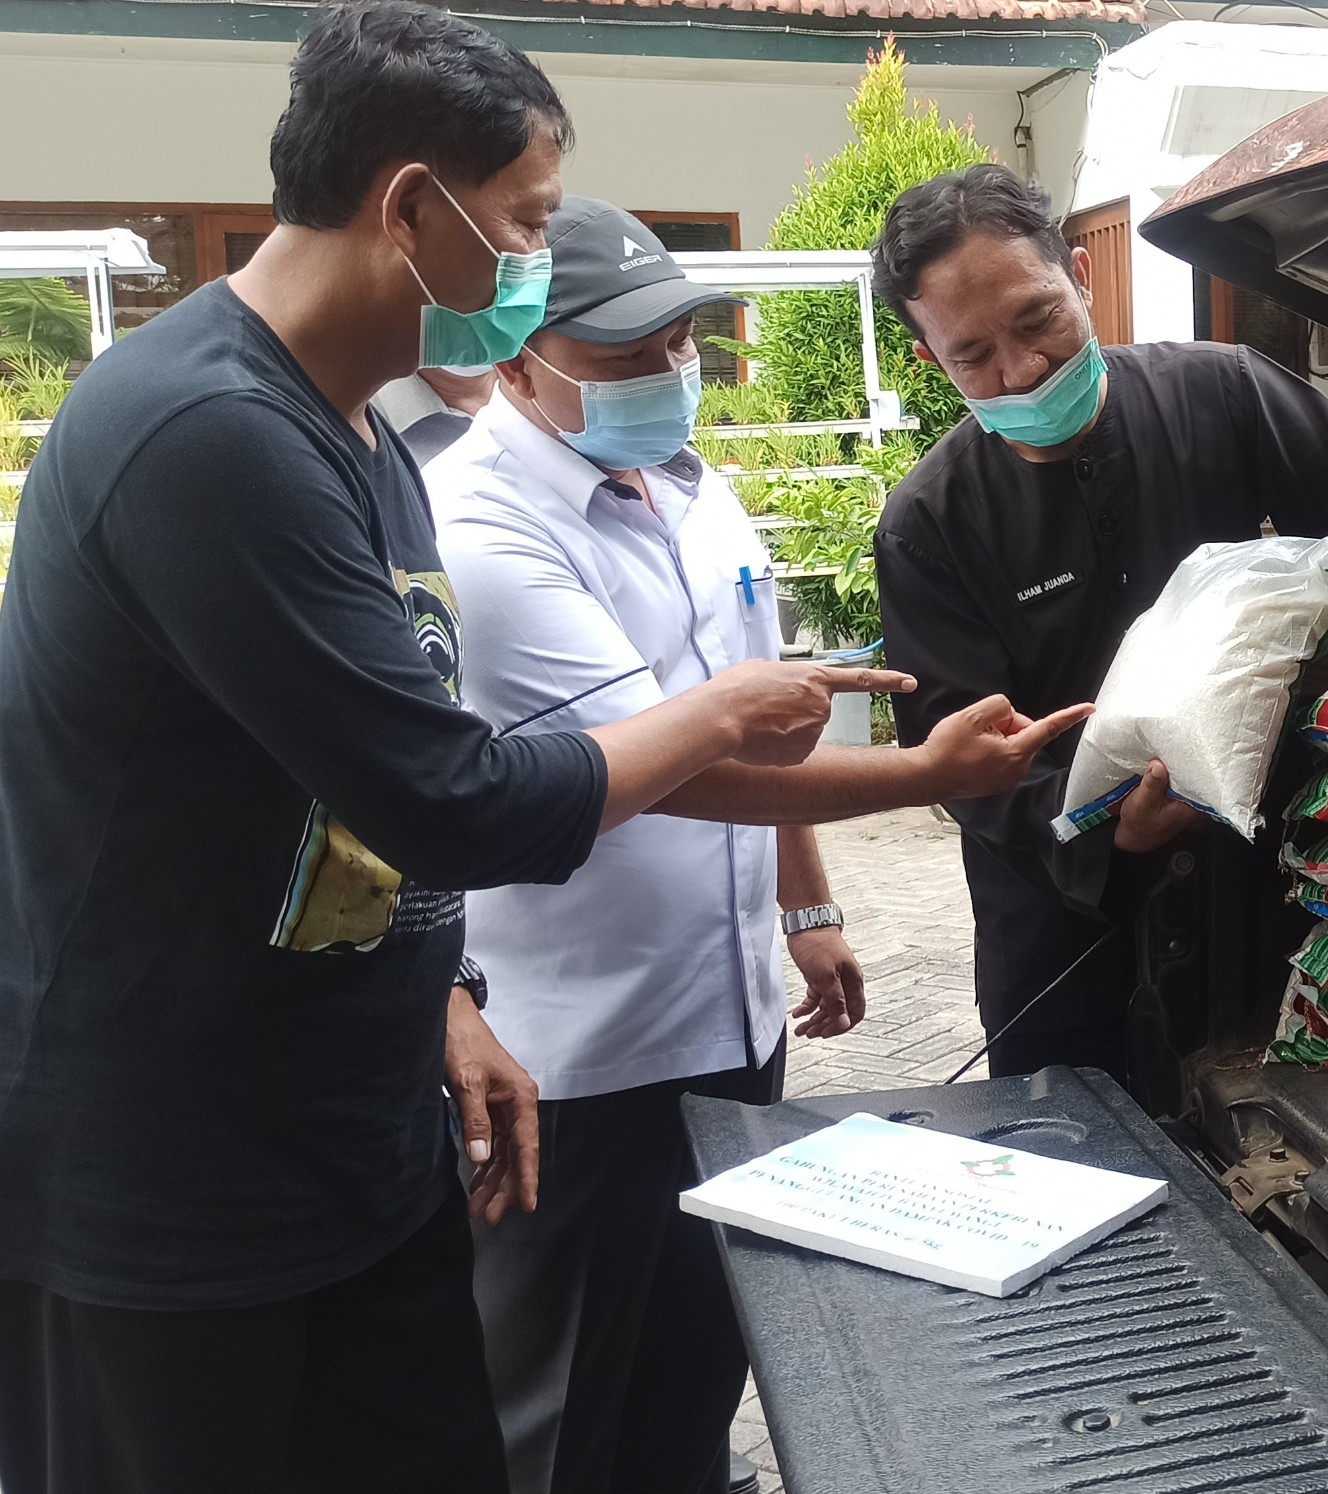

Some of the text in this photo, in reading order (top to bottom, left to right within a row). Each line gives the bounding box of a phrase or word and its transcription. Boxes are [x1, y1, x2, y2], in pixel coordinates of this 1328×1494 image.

[619, 254, 663, 272] EIGER
[1017, 571, 1075, 602] ILHAM JUANDA
